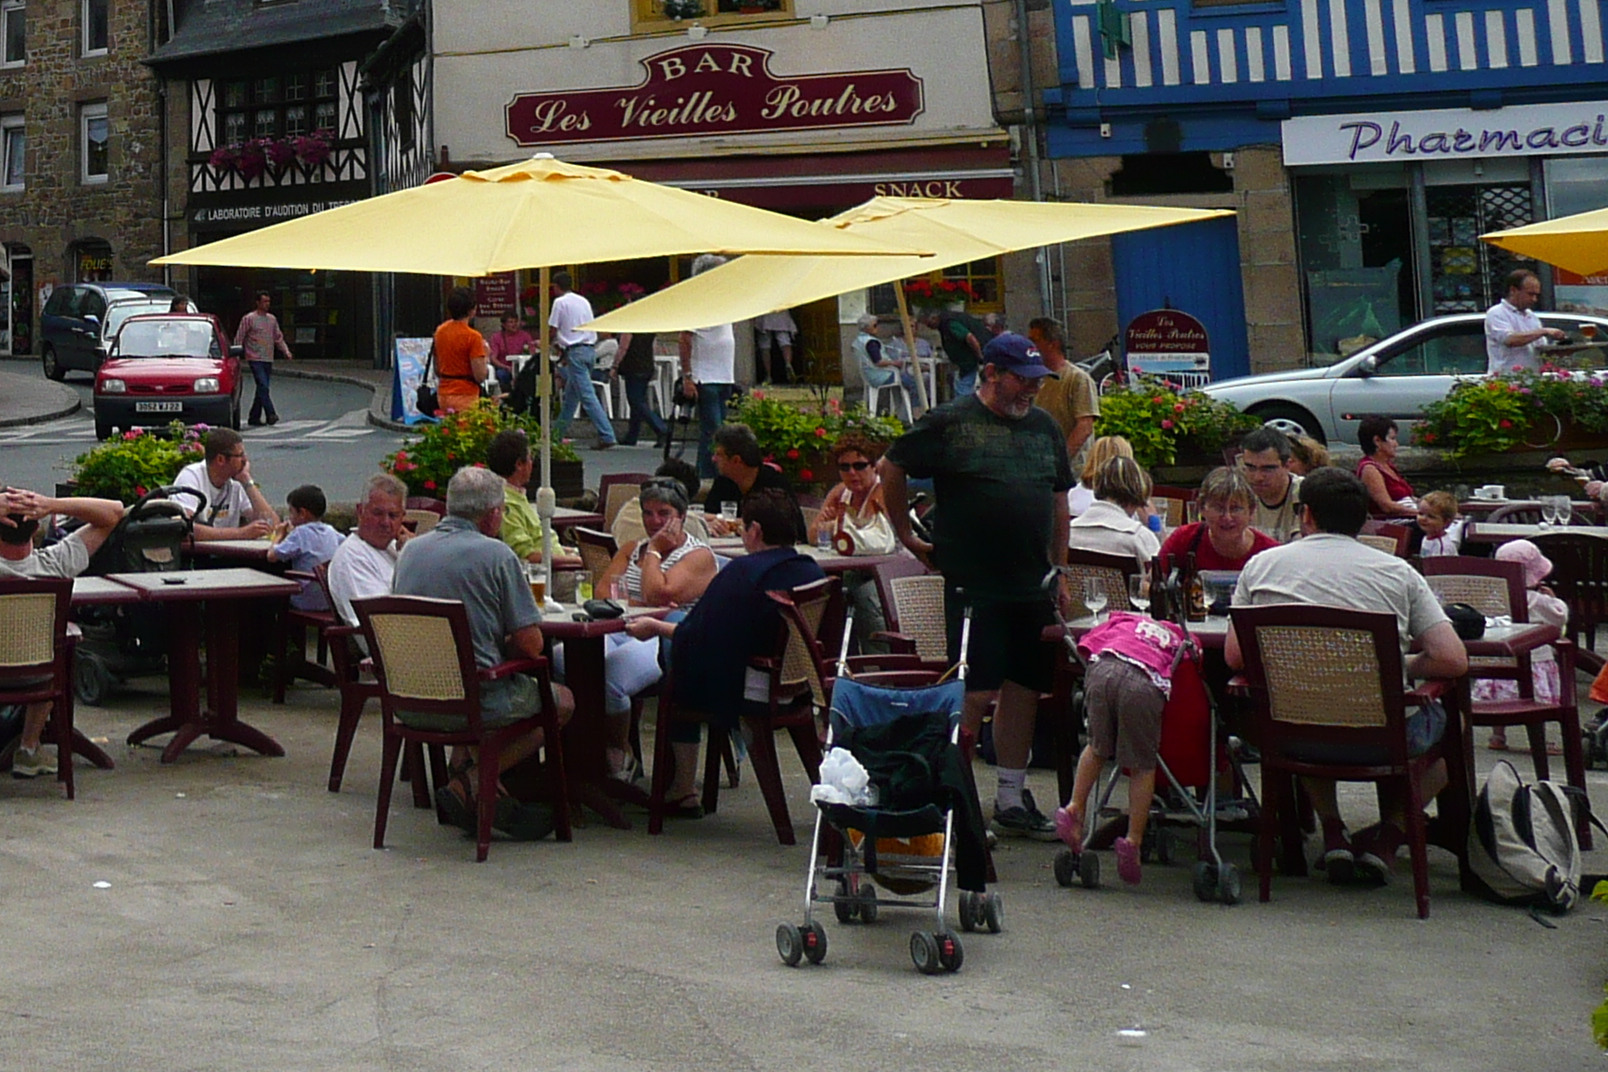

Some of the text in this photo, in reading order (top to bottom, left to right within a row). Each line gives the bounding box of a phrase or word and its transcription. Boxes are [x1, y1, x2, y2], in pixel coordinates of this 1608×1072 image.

[660, 50, 754, 82] BAR
[530, 83, 898, 134] Les Vieilles Poutres
[874, 180, 963, 198] SNACK
[208, 207, 261, 221] LABORATOIRE
[265, 204, 309, 217] D'AUDITION
[312, 202, 325, 214] DU
